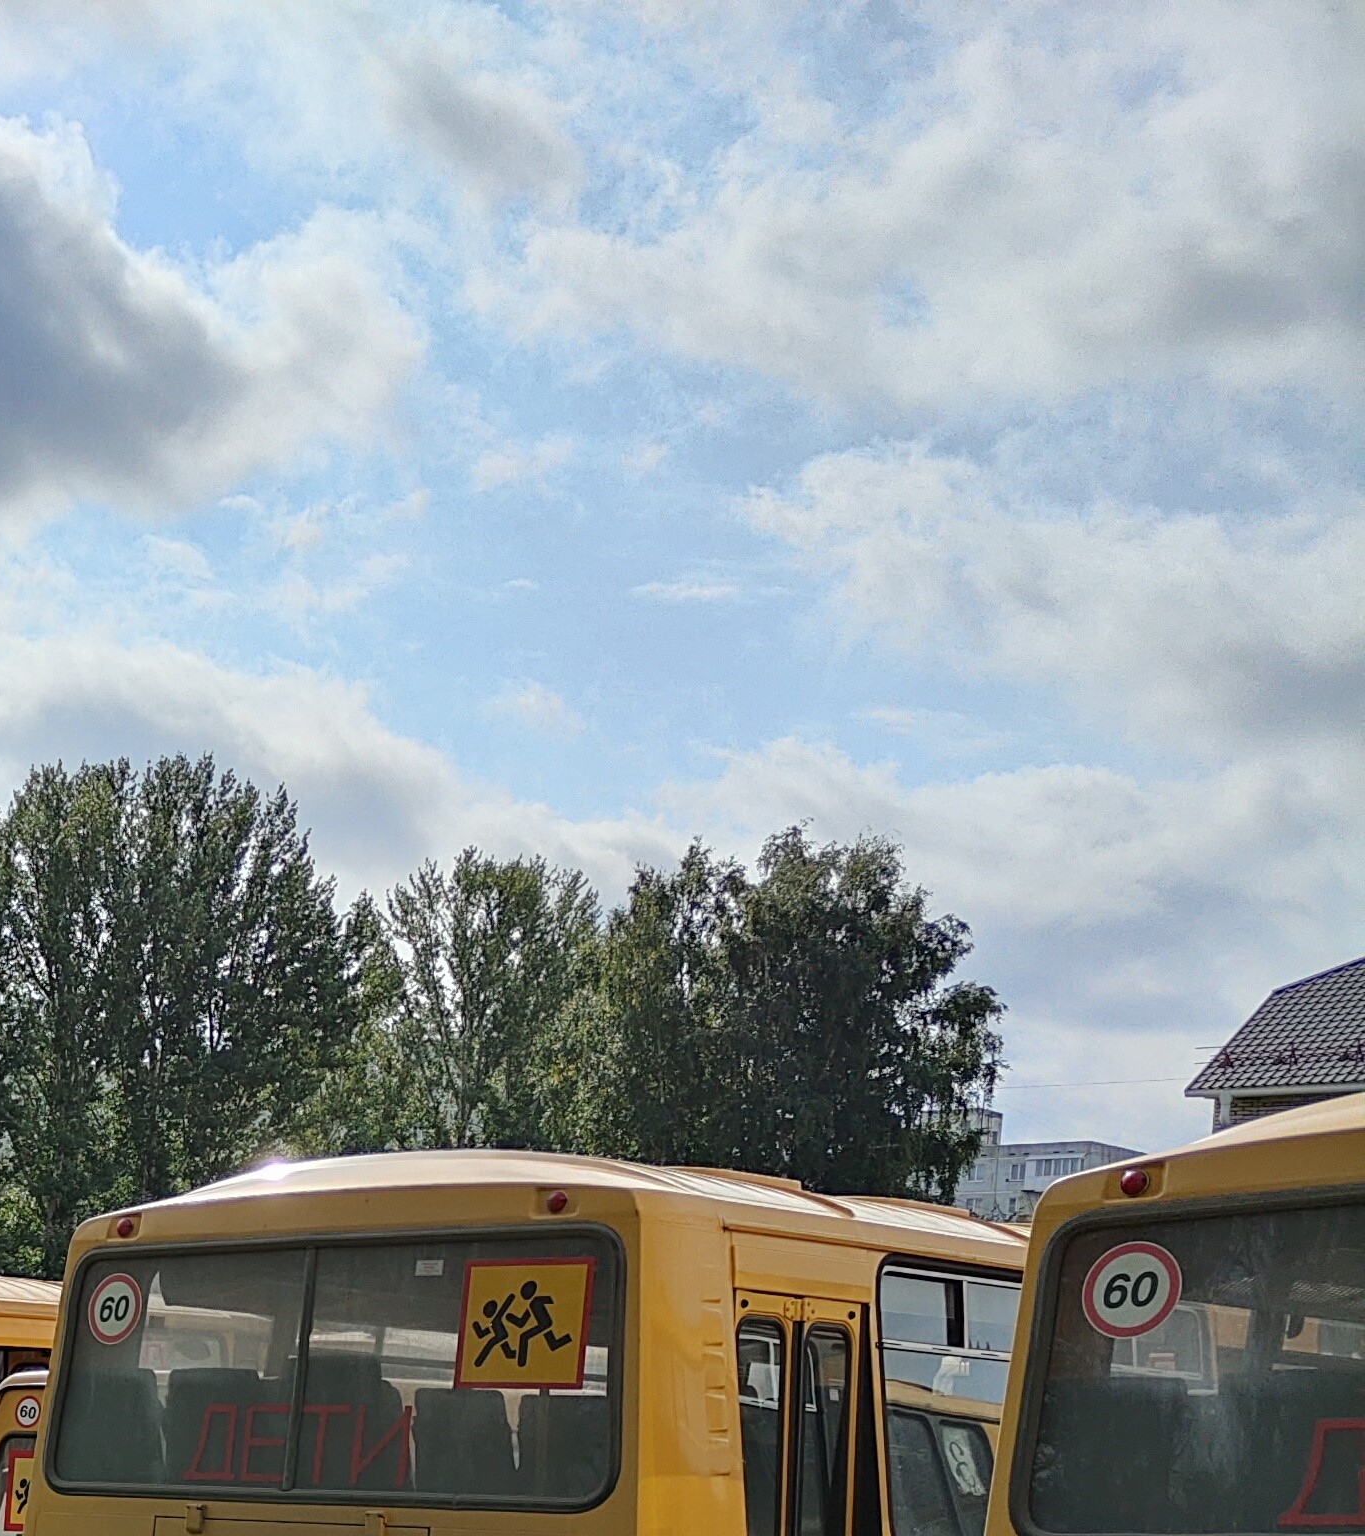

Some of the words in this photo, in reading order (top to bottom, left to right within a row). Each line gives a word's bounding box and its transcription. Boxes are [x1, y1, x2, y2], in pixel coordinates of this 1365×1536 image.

[1103, 1271, 1159, 1309] 60
[99, 1295, 130, 1323] 60
[19, 1404, 36, 1420] 60
[181, 1403, 413, 1488] ДЕТИ
